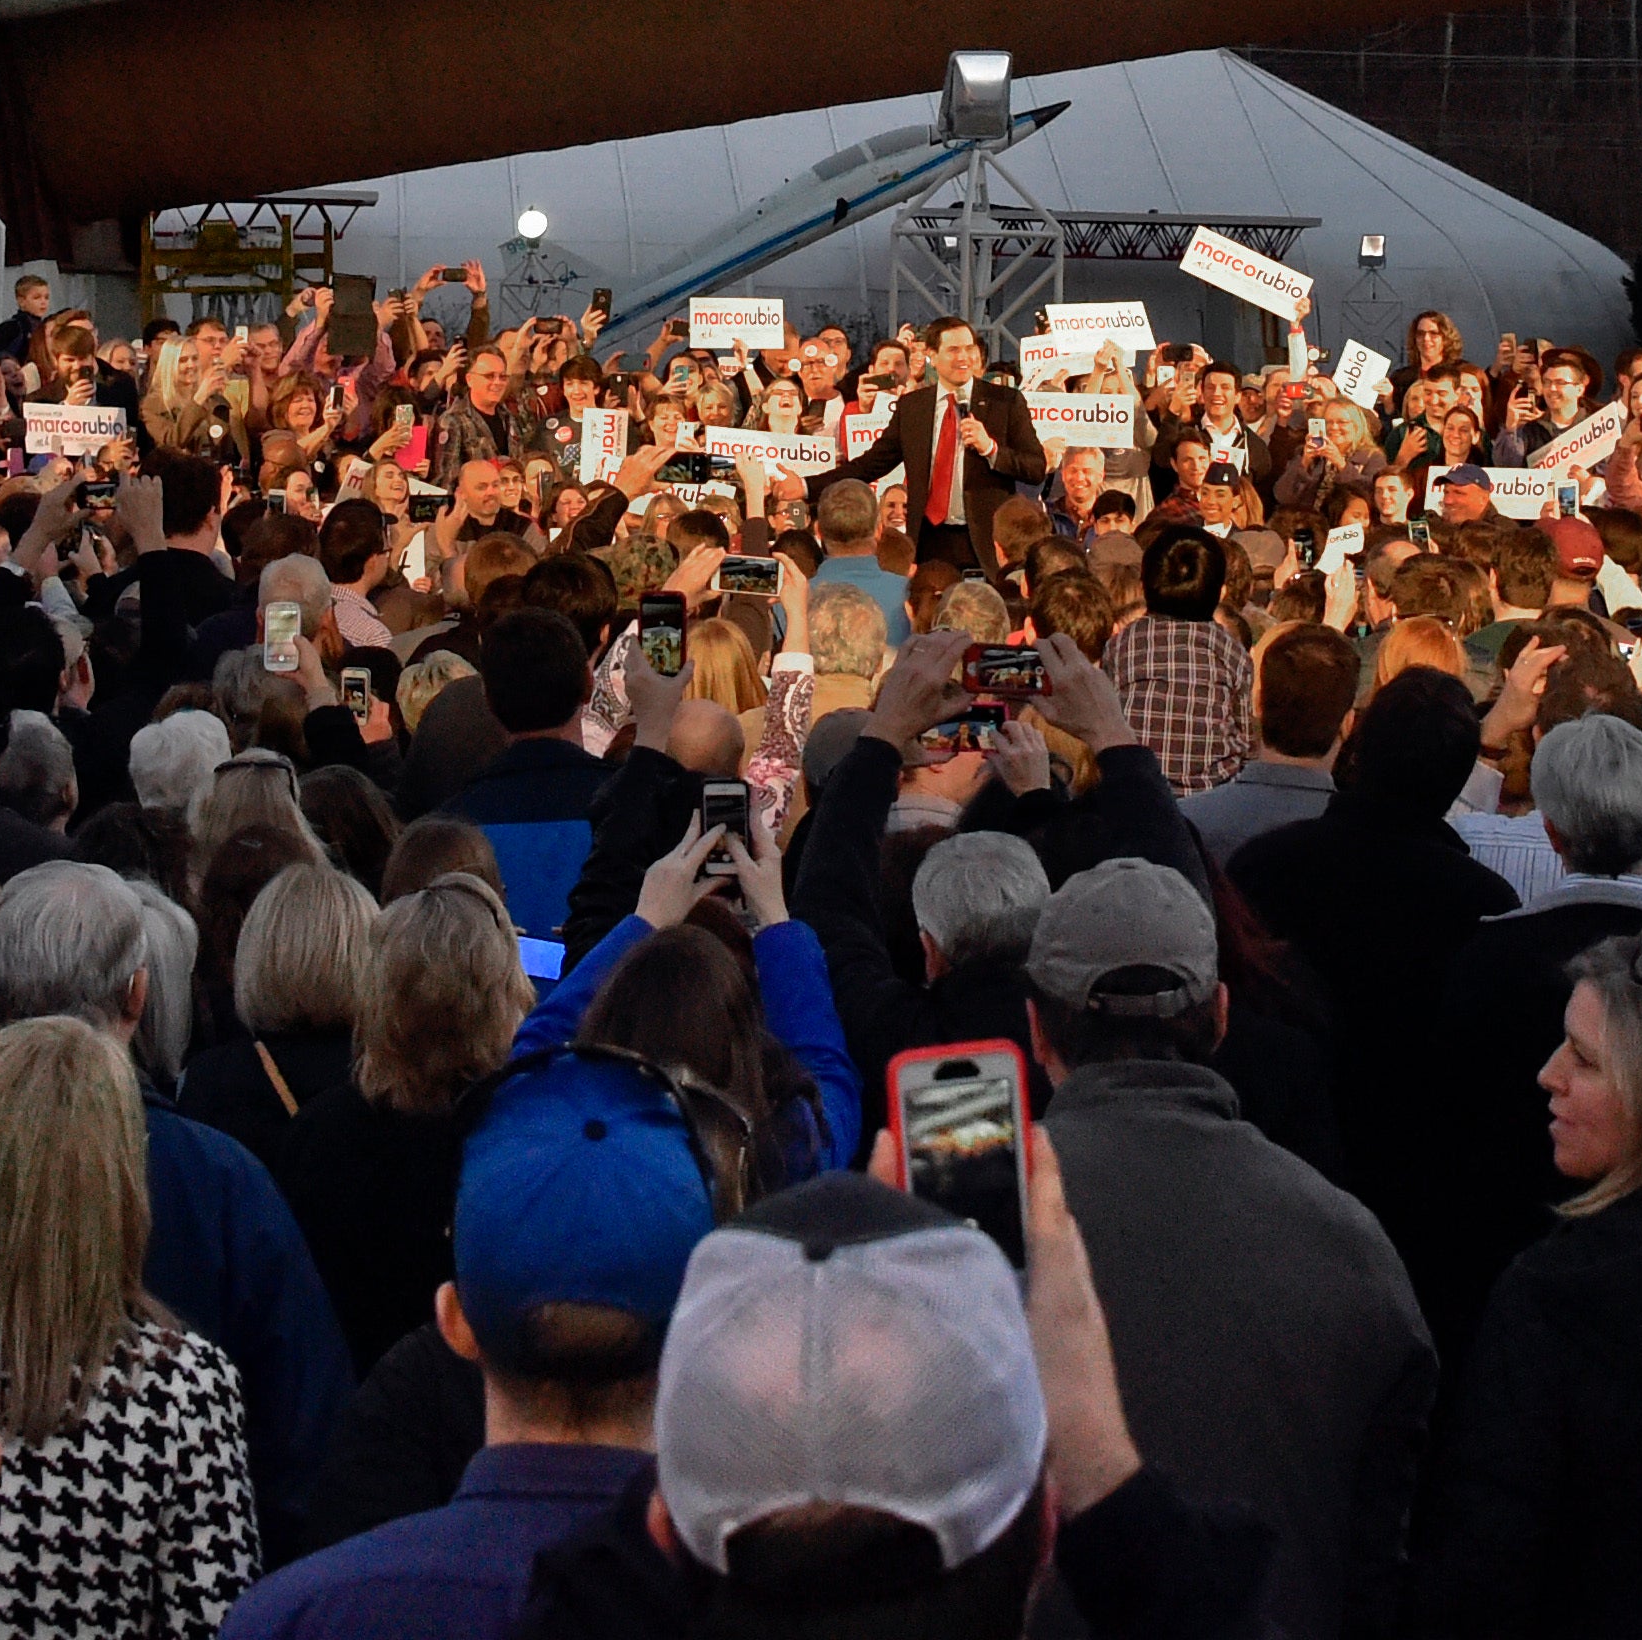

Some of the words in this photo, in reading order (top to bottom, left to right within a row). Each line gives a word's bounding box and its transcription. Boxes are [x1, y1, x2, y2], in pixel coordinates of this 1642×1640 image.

[1194, 240, 1303, 298] marcorubio
[694, 306, 780, 325] marcorubio
[1054, 309, 1145, 330] marcorubio
[1029, 402, 1129, 424] arcorubio
[28, 414, 123, 435] marcorubio
